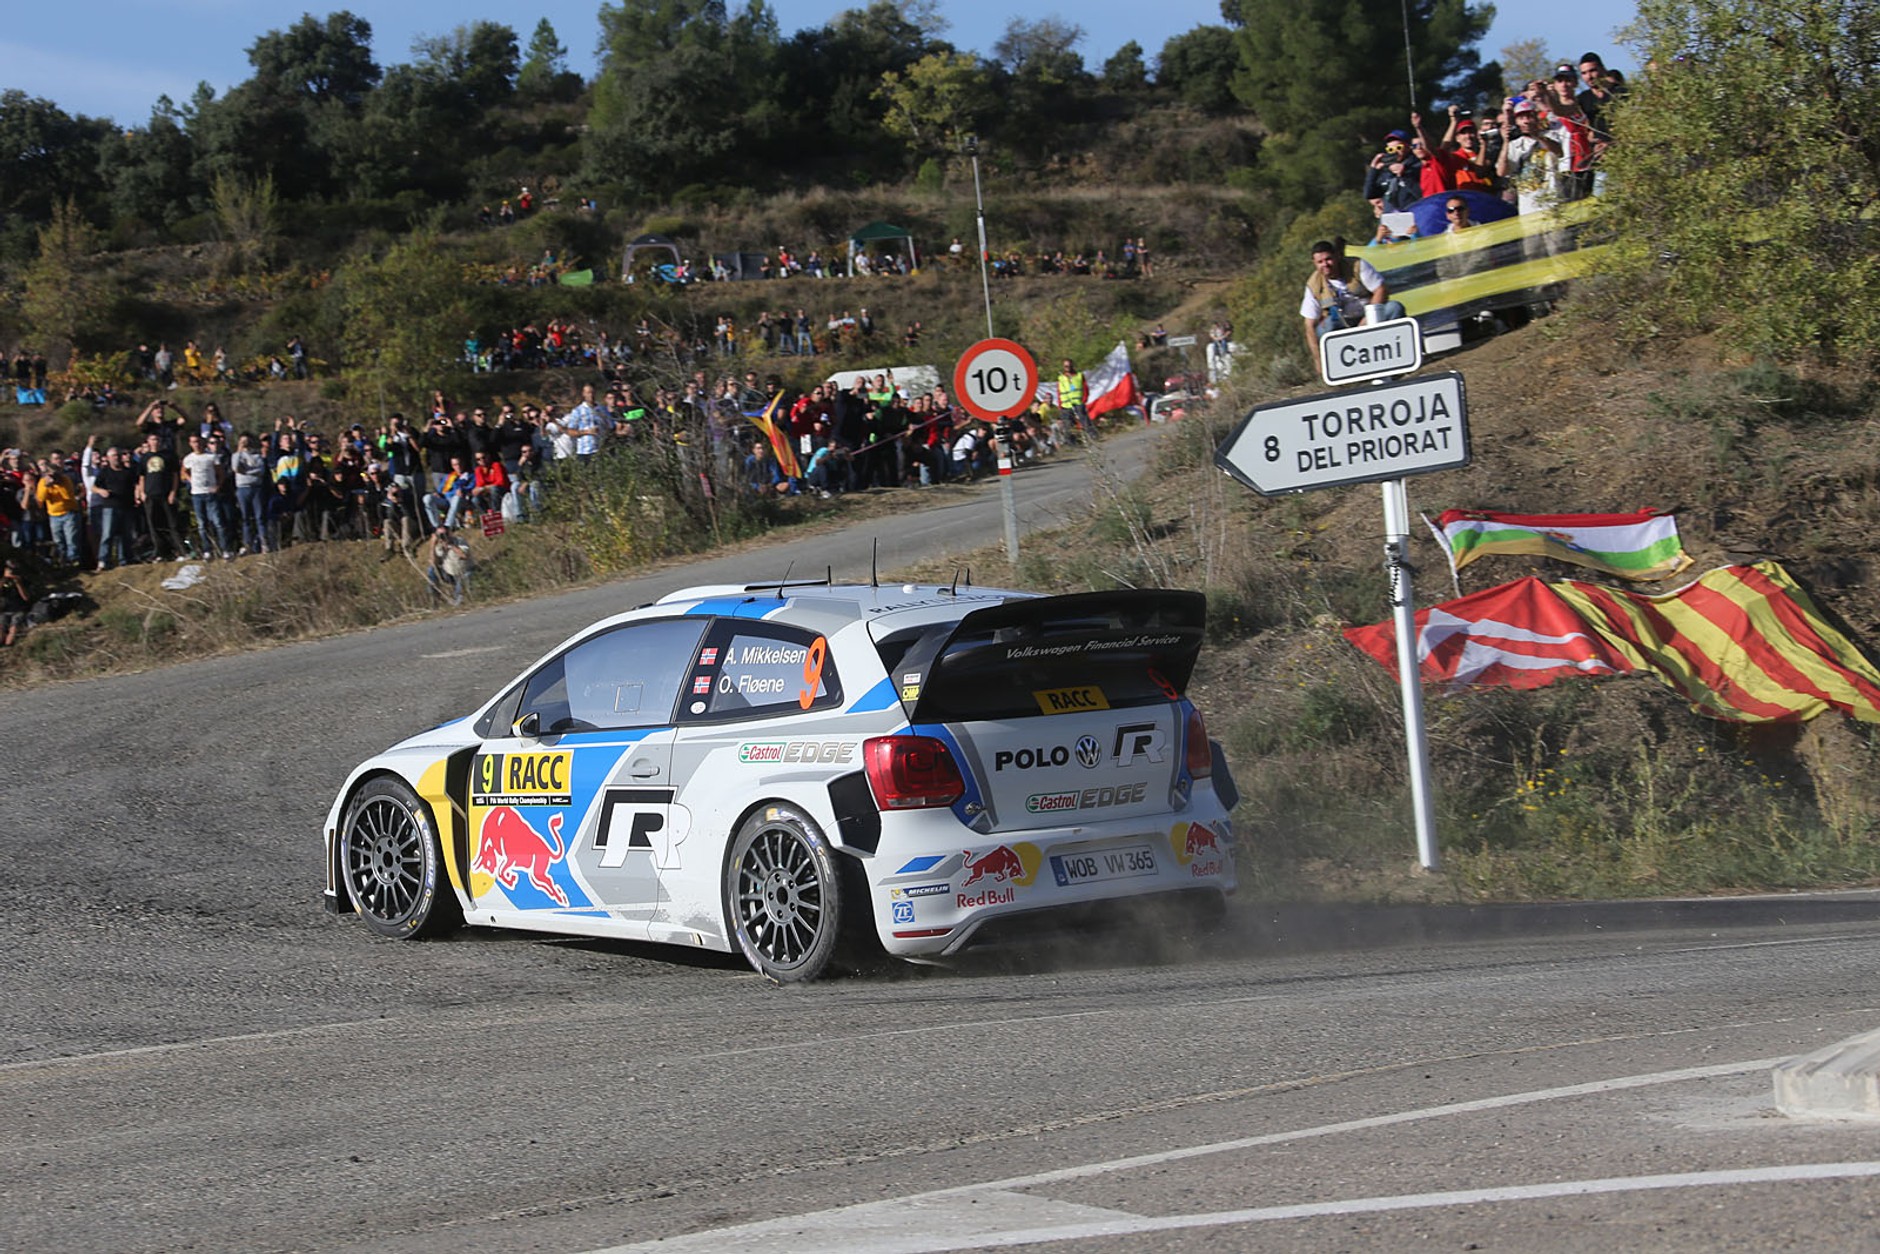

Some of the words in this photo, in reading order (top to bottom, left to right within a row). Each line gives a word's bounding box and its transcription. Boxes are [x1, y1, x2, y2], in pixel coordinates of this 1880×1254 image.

[1340, 336, 1402, 367] Camí
[971, 367, 1007, 394] 10
[1013, 373, 1022, 391] t
[1302, 393, 1450, 441] TORROJA
[1264, 436, 1280, 462] 8
[1297, 447, 1341, 473] DEL
[1348, 427, 1451, 464] PRIORAT
[723, 648, 737, 664] A.
[741, 646, 806, 664] Mikkelsen
[1006, 643, 1081, 660] Volkswagen
[1084, 636, 1136, 651] Financial
[1137, 633, 1181, 648] Services
[719, 677, 734, 694] O.
[738, 675, 785, 694] Fløene
[799, 636, 827, 710] 9
[1047, 689, 1098, 711] RACC
[749, 745, 782, 761] Castrol
[783, 741, 857, 763] EDGE
[995, 746, 1069, 771] POLO
[481, 755, 494, 793] 9
[509, 755, 564, 790] RACC
[1038, 793, 1077, 811] Castrol
[1079, 782, 1147, 810] EDGE
[1065, 853, 1098, 878] WOB
[1103, 853, 1125, 874] VW
[1124, 850, 1155, 872] 365
[908, 885, 949, 895] MICHELIN
[956, 890, 986, 908] Red
[987, 888, 1015, 905] Bull
[897, 906, 912, 919] ZF
